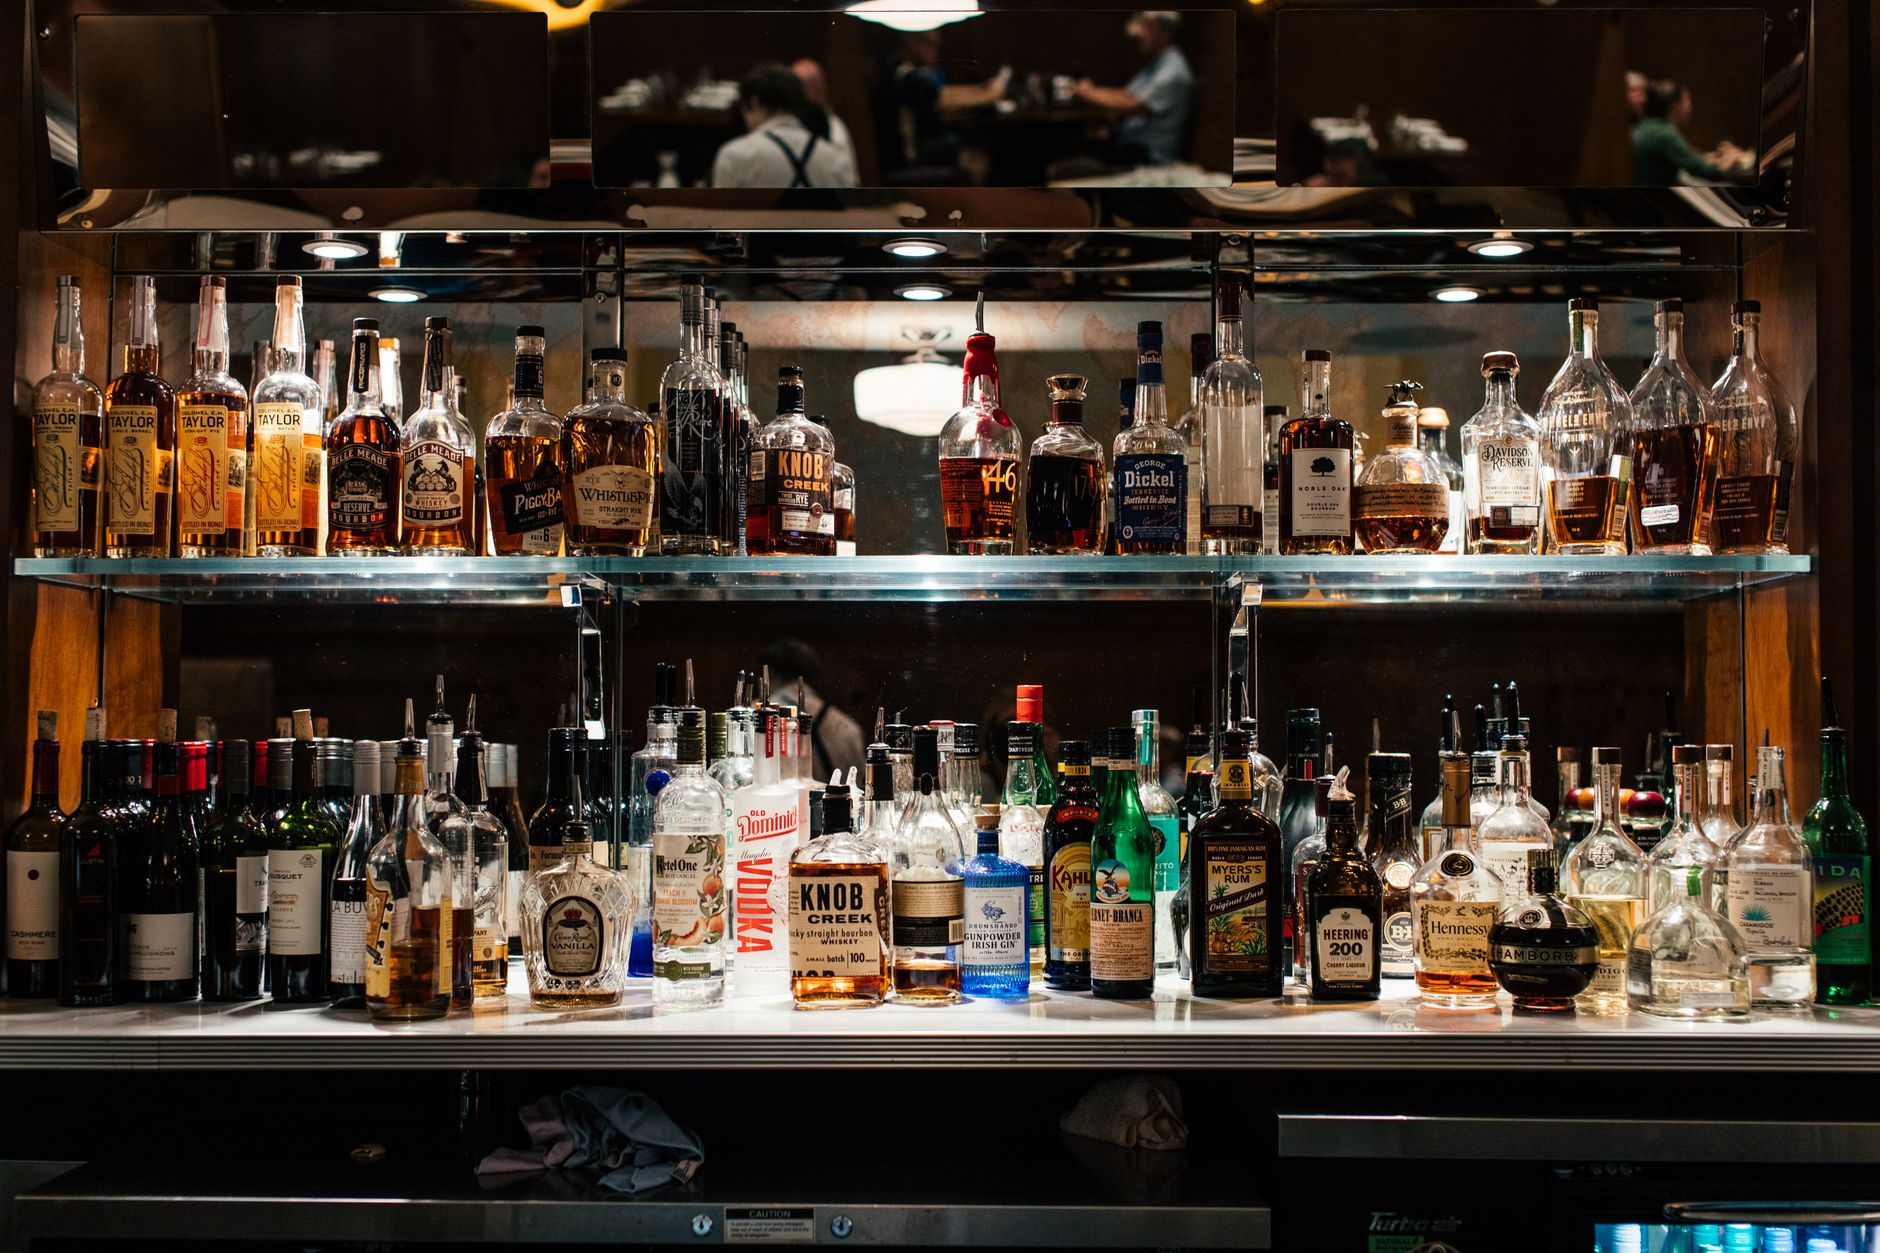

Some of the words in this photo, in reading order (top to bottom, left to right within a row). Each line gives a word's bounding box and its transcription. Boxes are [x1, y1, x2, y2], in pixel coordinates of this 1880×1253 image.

[34, 413, 77, 426] TAYLOR
[110, 416, 155, 428] TAYLOR
[181, 416, 225, 428] TAYLOR
[257, 414, 301, 426] TAYLOR
[331, 448, 354, 466] BELLE
[356, 448, 388, 467] MEADE
[405, 444, 428, 461] BELLE
[430, 444, 462, 462] MEADE
[1481, 443, 1534, 462] DAVIDSON
[778, 450, 824, 480] KNOB
[1134, 459, 1167, 470] GEORGE
[1491, 456, 1534, 473] RESERVE
[984, 459, 1017, 493] 46
[1124, 470, 1175, 488] Dickel
[783, 479, 829, 492] CREEK
[514, 487, 562, 515] PIGGYBA
[796, 494, 809, 505] RYE
[1123, 495, 1149, 505] Bottled
[343, 502, 371, 513] RESERVE
[406, 509, 457, 519] BOURBON
[598, 506, 629, 514] STRAIGHT
[331, 512, 384, 523] BOURBON
[543, 528, 550, 542] 6
[750, 809, 766, 817] OLD
[540, 851, 564, 859] Formul
[655, 855, 677, 875] Ketel
[677, 859, 698, 872] One
[1211, 865, 1262, 875] MYERS'S
[1052, 863, 1092, 893] KAHL
[1224, 874, 1250, 883] RUM
[1818, 865, 1861, 879] IDA
[800, 882, 864, 912] KNOB
[344, 902, 367, 914] BUV
[736, 857, 773, 953] VODKA
[1209, 895, 1242, 913] Original
[807, 914, 873, 924] CREEK
[1090, 908, 1143, 923] ERNET-BRANCA
[806, 928, 839, 941] straight
[841, 928, 873, 938] bourbon
[1323, 928, 1369, 941] HEERING
[1431, 920, 1490, 938] Hennessy
[963, 931, 1022, 941] GUNPOWDER
[551, 942, 595, 950] VANILLA
[971, 941, 998, 950] IRISH
[1000, 940, 1016, 949] GIN
[1329, 942, 1363, 956] 200
[827, 953, 845, 963] batch
[850, 952, 865, 963] 100
[748, 1210, 791, 1218] CAUTION
[1368, 1211, 1430, 1232] Turbo
